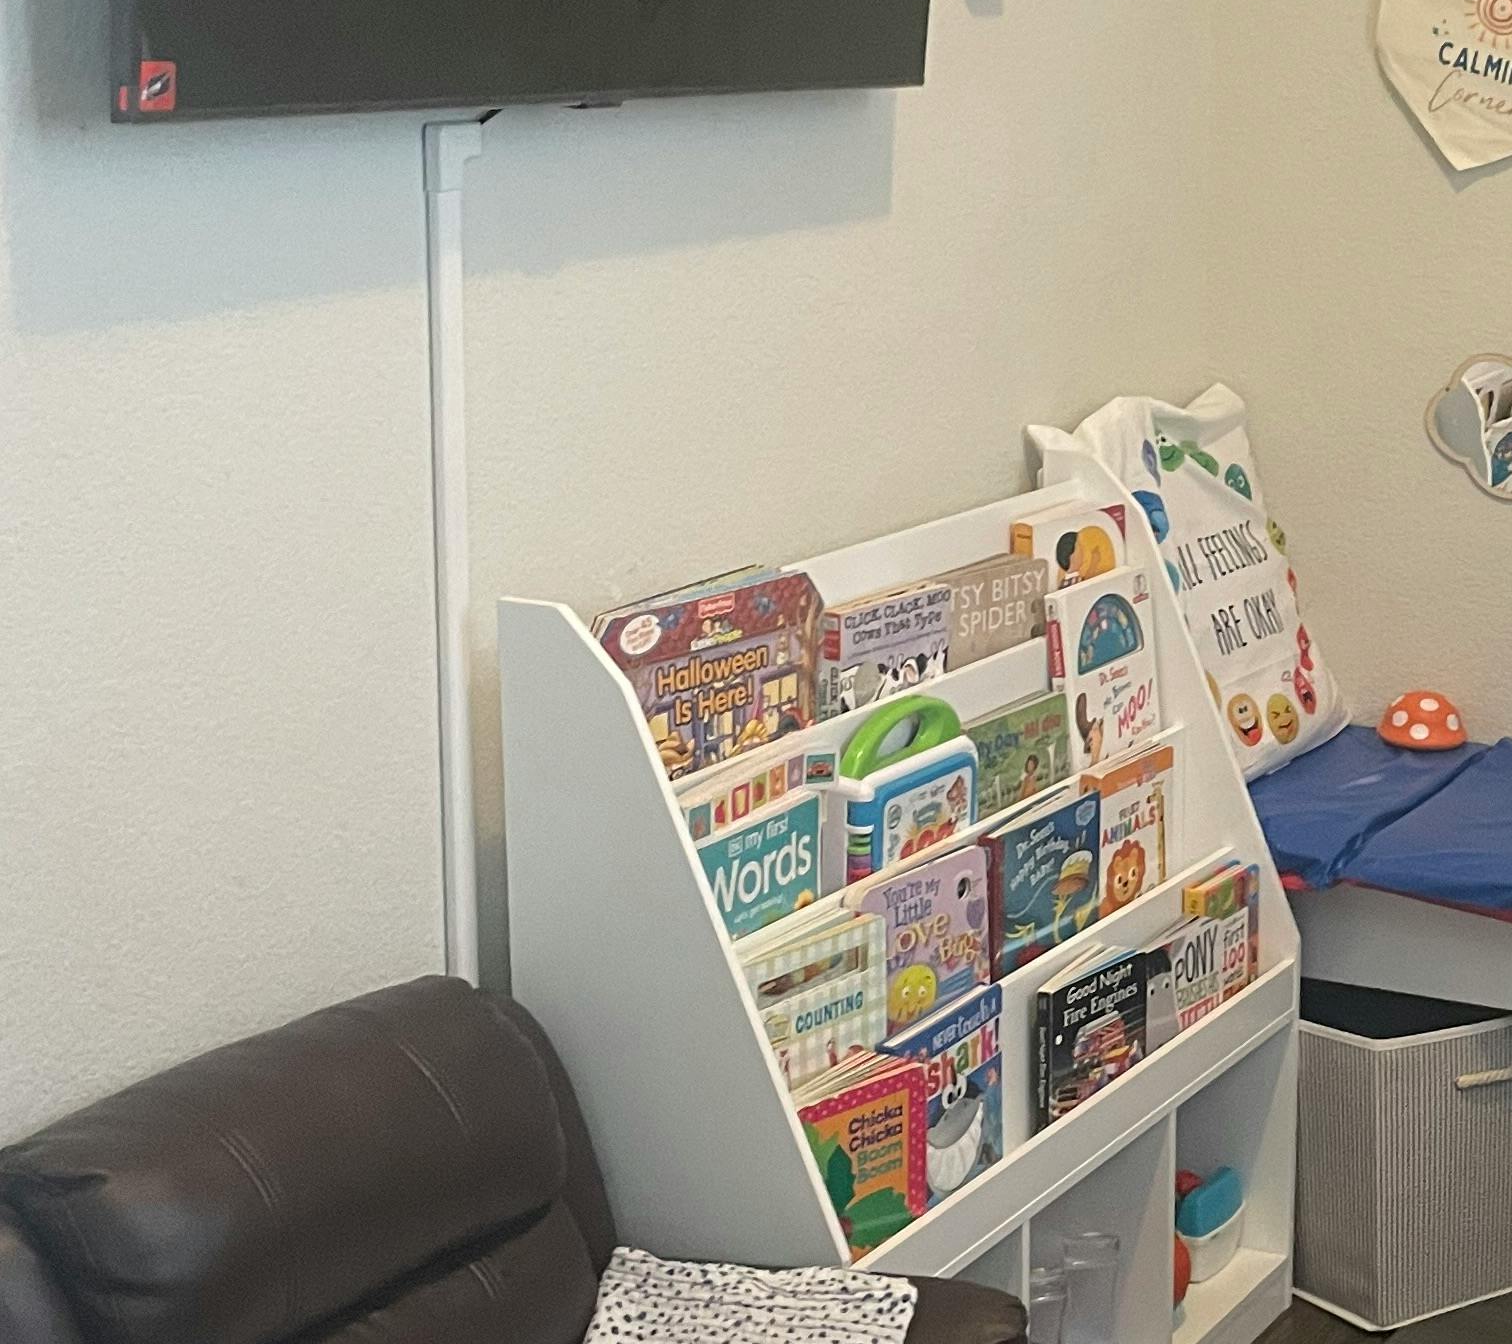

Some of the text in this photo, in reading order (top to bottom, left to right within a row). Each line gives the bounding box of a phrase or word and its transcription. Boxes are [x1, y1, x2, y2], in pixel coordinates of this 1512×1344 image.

[1197, 519, 1268, 581] FEELINGS
[950, 568, 1047, 612] TSY BITSY
[958, 600, 1027, 638] SPIDER
[1210, 588, 1284, 656] ARE OKAY
[656, 644, 769, 697] Halloween
[674, 675, 754, 726] Is Here!
[1117, 678, 1154, 739] MOO!
[1101, 805, 1156, 849] ANIMALS
[893, 897, 933, 929] Little
[895, 913, 952, 954] ove
[1174, 923, 1219, 990] PONY
[1222, 941, 1246, 973] 100
[1063, 981, 1138, 1028] Fire Engines
[1066, 963, 1133, 1006] Good Night
[795, 991, 864, 1034] COUNTING
[928, 1017, 1000, 1097] shark!
[848, 1104, 903, 1135] Chicka
[848, 1123, 903, 1152] Chicka
